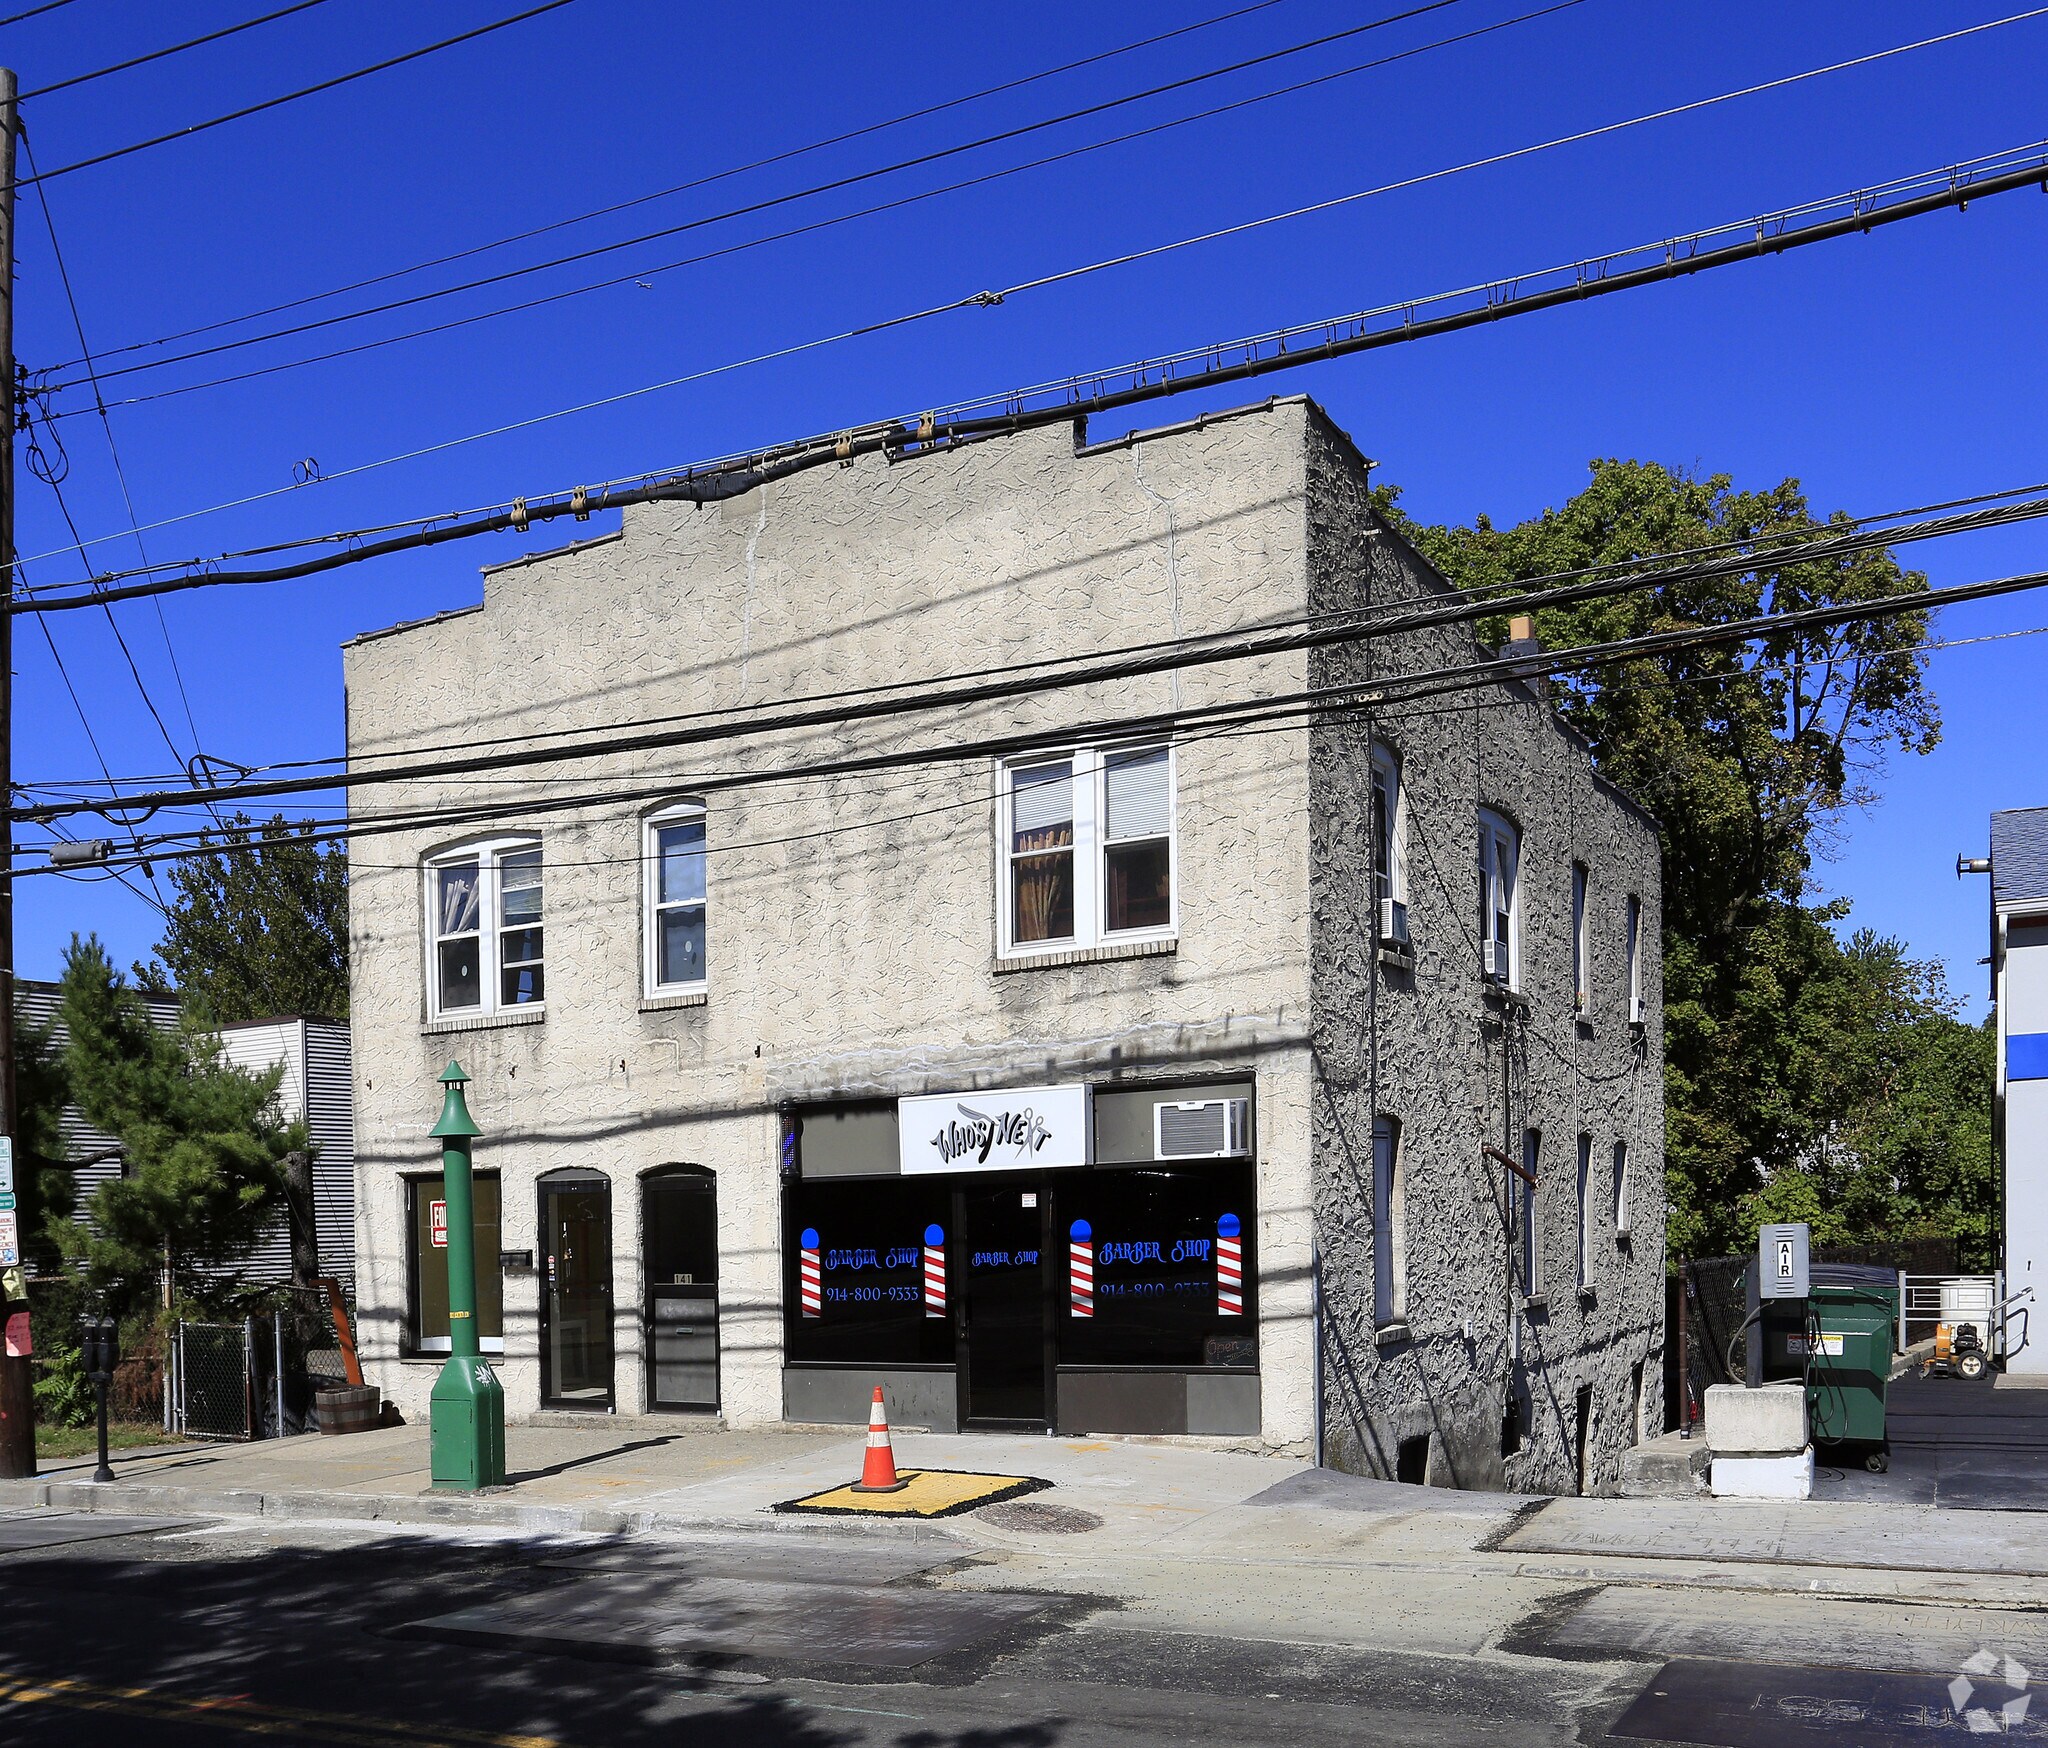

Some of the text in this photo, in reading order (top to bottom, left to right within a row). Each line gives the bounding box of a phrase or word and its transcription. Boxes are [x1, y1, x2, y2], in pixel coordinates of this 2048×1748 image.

[930, 1107, 1052, 1164] WHO'S NEXT
[825, 1247, 919, 1270] BARBER SHOP
[971, 1250, 1039, 1267] BARBER SHOP
[1099, 1239, 1211, 1265] BARBER SHOP
[1781, 1243, 1790, 1275] AIR
[675, 1274, 691, 1284] 141
[826, 1287, 919, 1302] 914-800-9333
[1101, 1283, 1209, 1299] 914-800-9333
[1206, 1339, 1239, 1360] Open
